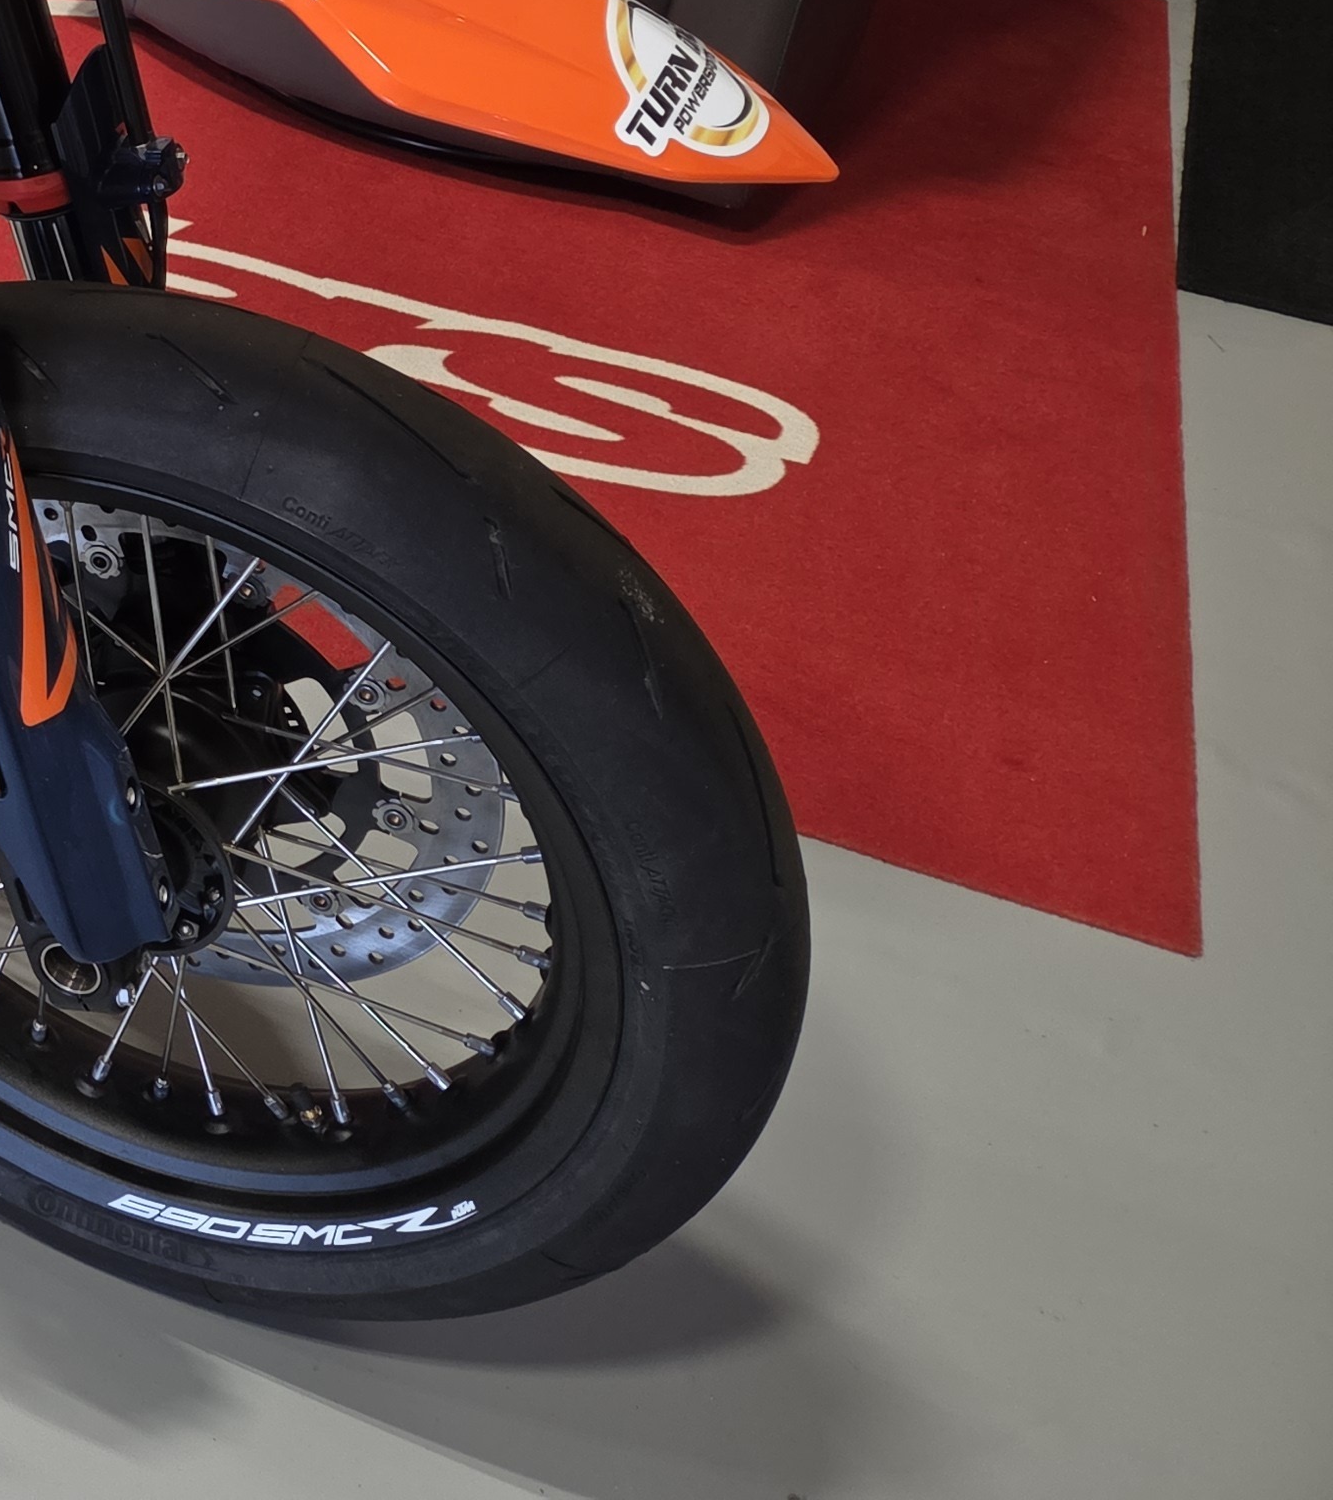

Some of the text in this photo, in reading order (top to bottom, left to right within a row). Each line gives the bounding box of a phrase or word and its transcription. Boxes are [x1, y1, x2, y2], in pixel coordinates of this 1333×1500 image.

[625, 43, 699, 147] TURN
[4, 452, 20, 573] SMC
[450, 1199, 477, 1219] KTM
